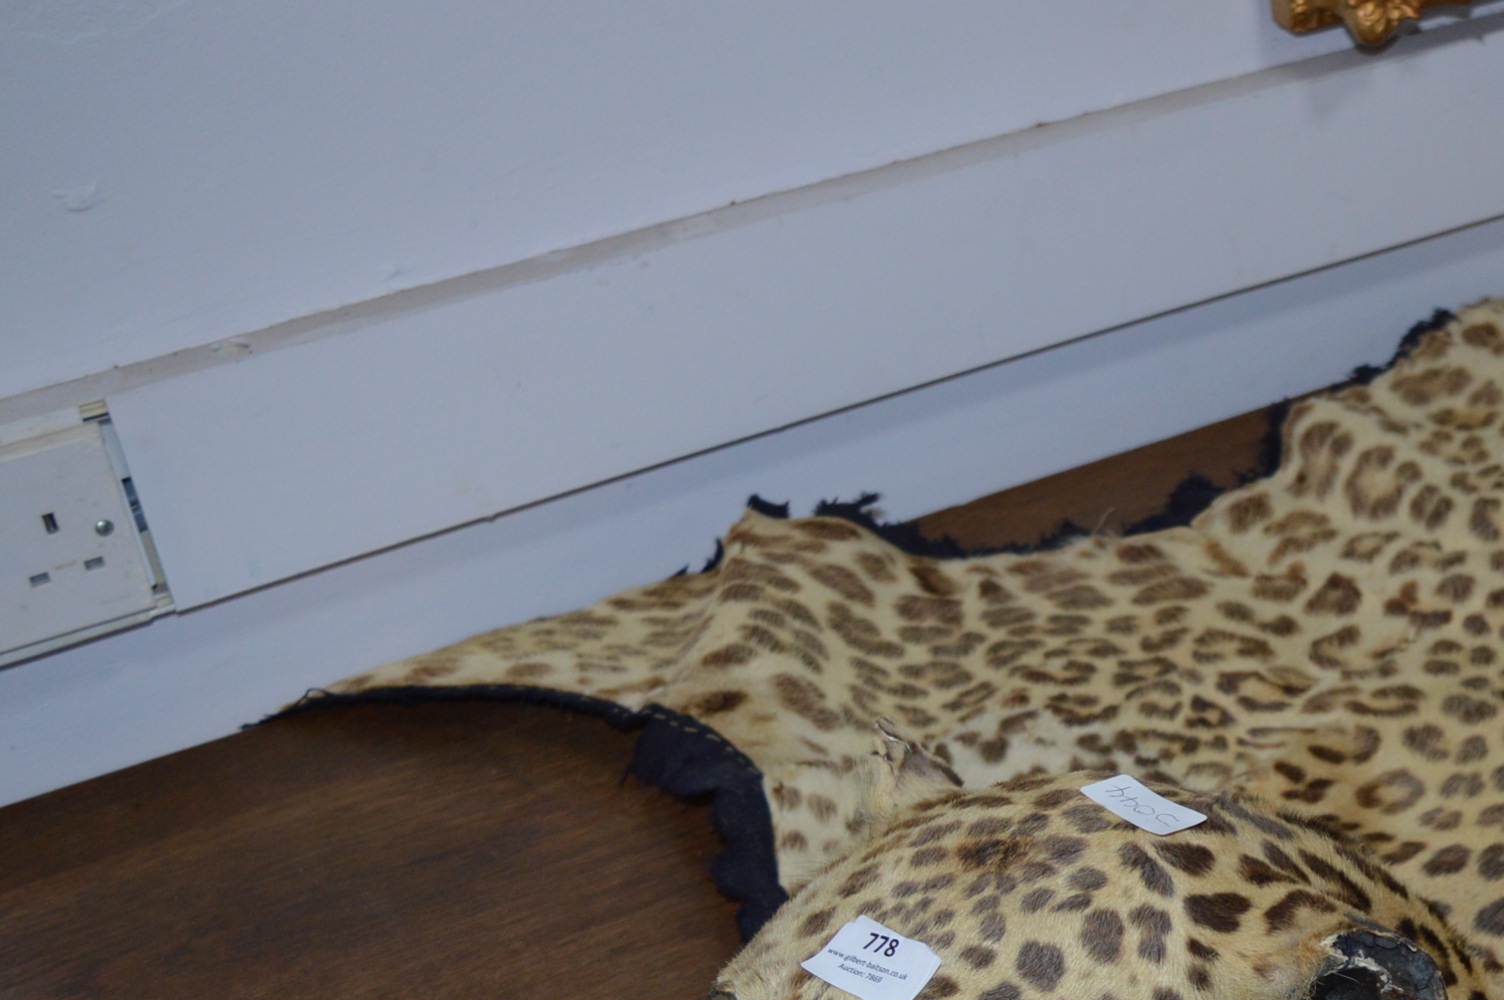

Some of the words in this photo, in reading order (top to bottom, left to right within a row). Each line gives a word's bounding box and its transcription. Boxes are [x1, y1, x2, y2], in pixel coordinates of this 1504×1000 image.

[862, 932, 899, 957] 778
[827, 947, 908, 980] www.gilbert-baitson.co.uk
[837, 963, 866, 978] Auction:
[865, 972, 883, 983] 7869
